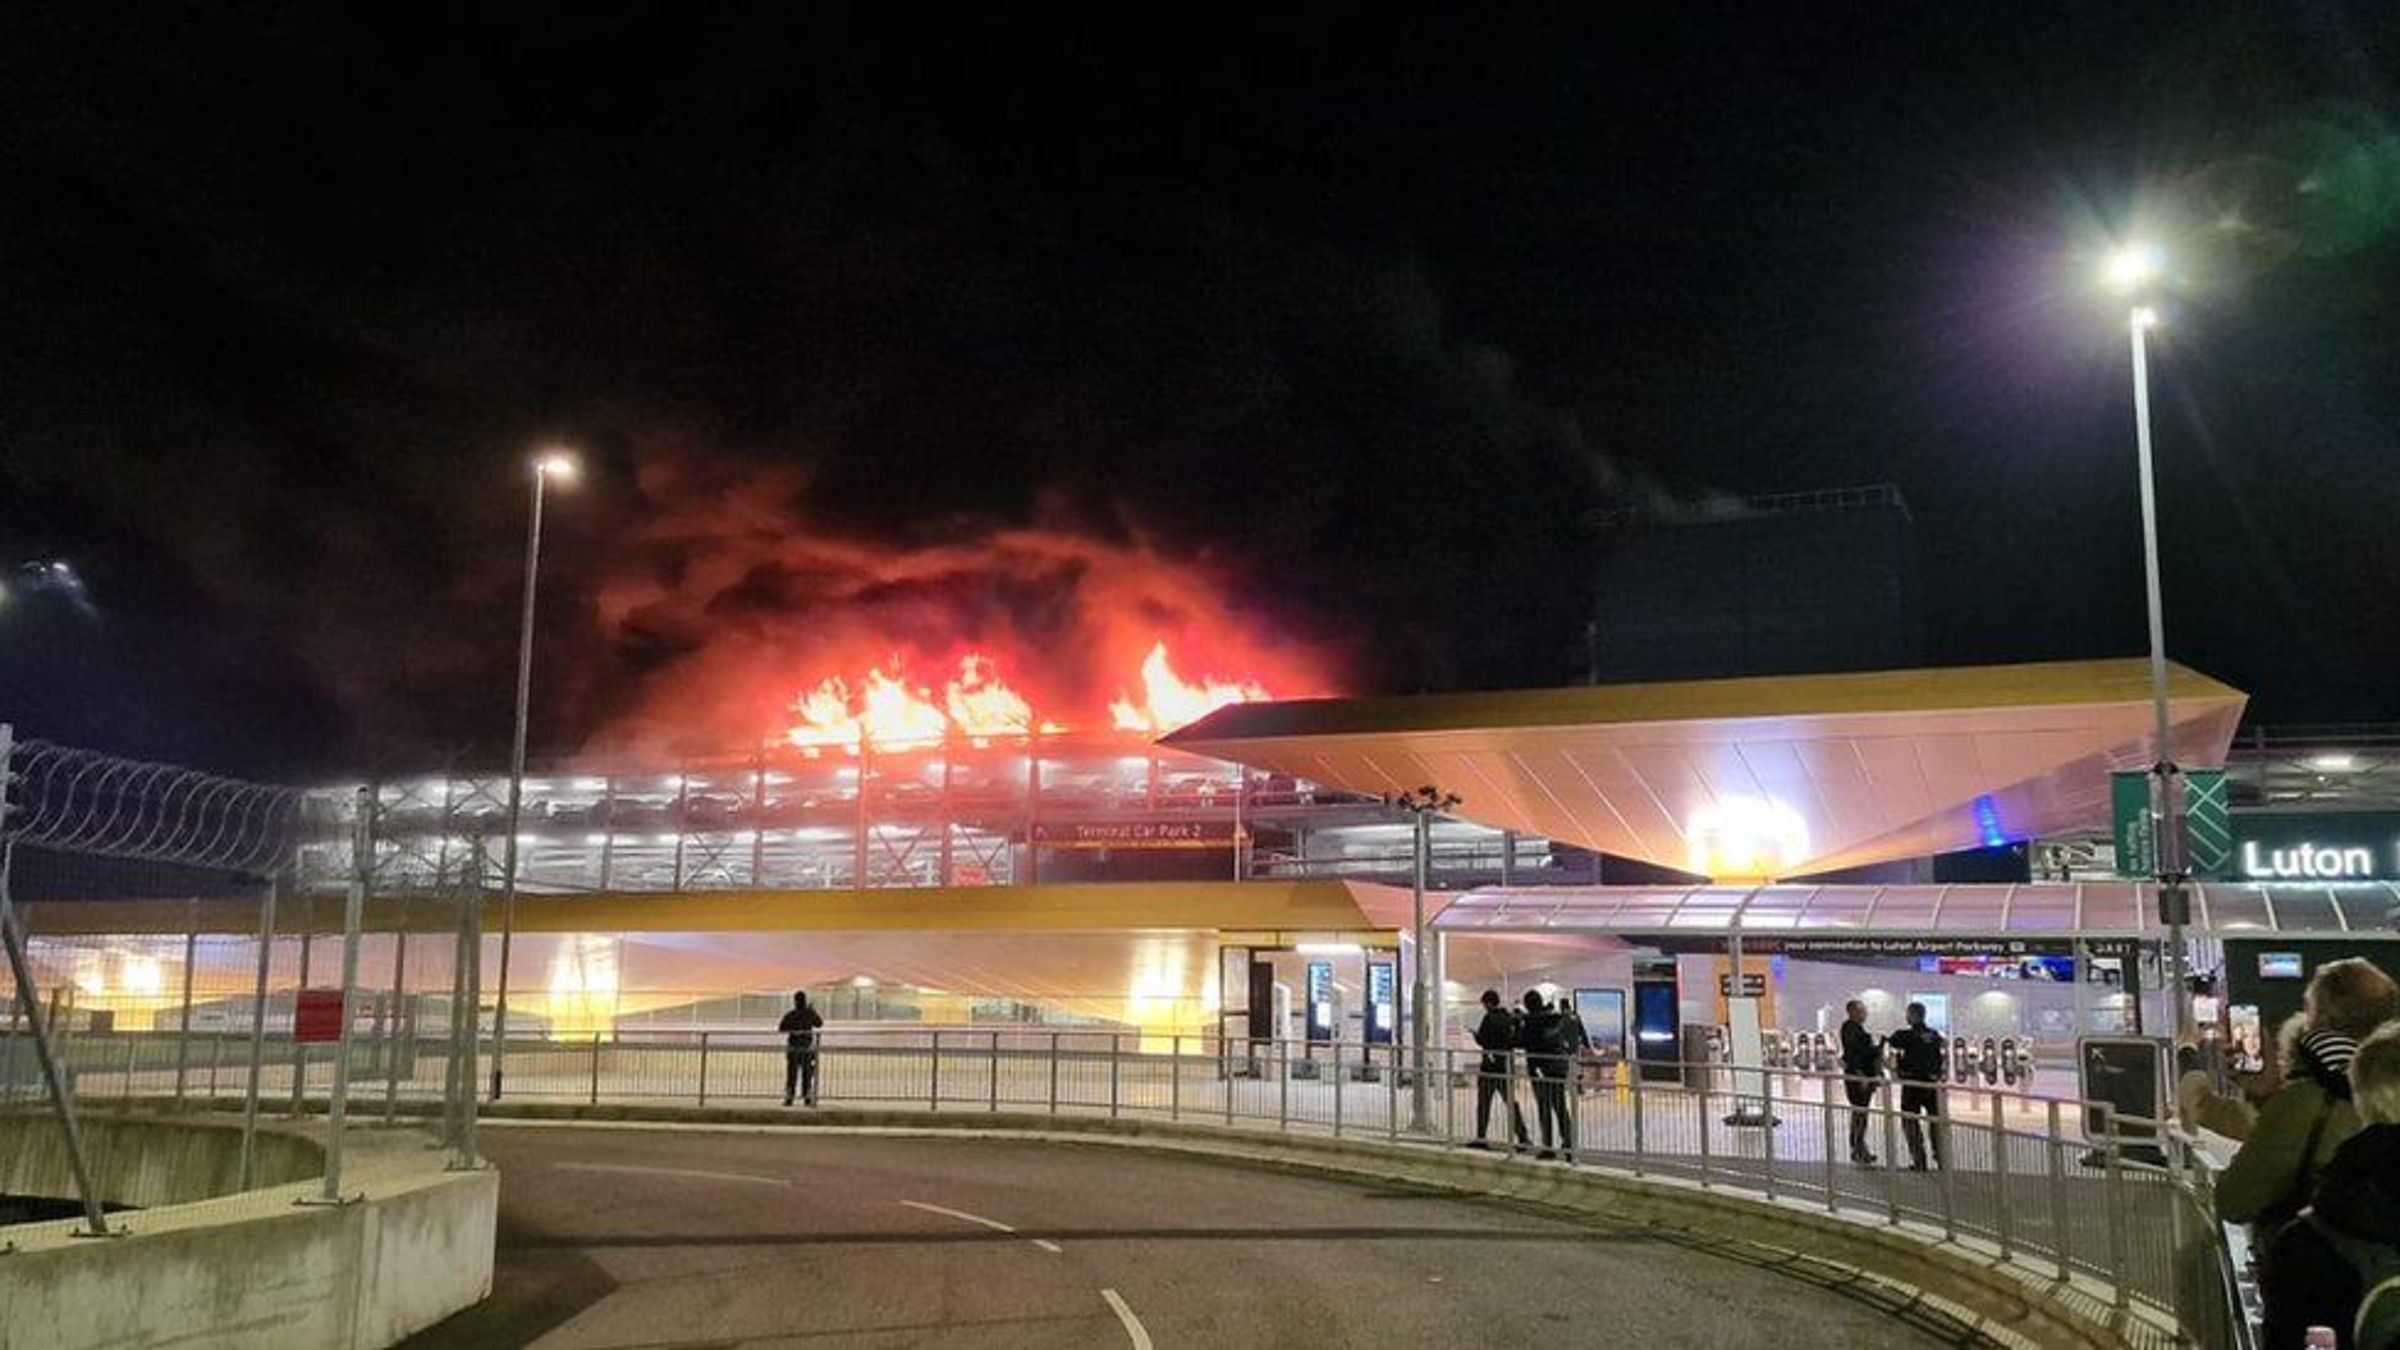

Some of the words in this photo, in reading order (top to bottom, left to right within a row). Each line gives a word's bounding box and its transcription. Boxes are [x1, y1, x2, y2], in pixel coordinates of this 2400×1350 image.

[1076, 825, 1130, 838] Terminal
[1133, 825, 1155, 838] Car
[1159, 825, 1188, 838] Park
[2244, 840, 2371, 877] Luton
[1809, 940, 1867, 950] connection
[1870, 941, 1881, 950] to
[1883, 941, 1913, 951] Luton
[1916, 941, 1953, 952] Airport
[1956, 942, 2004, 953] Parkway
